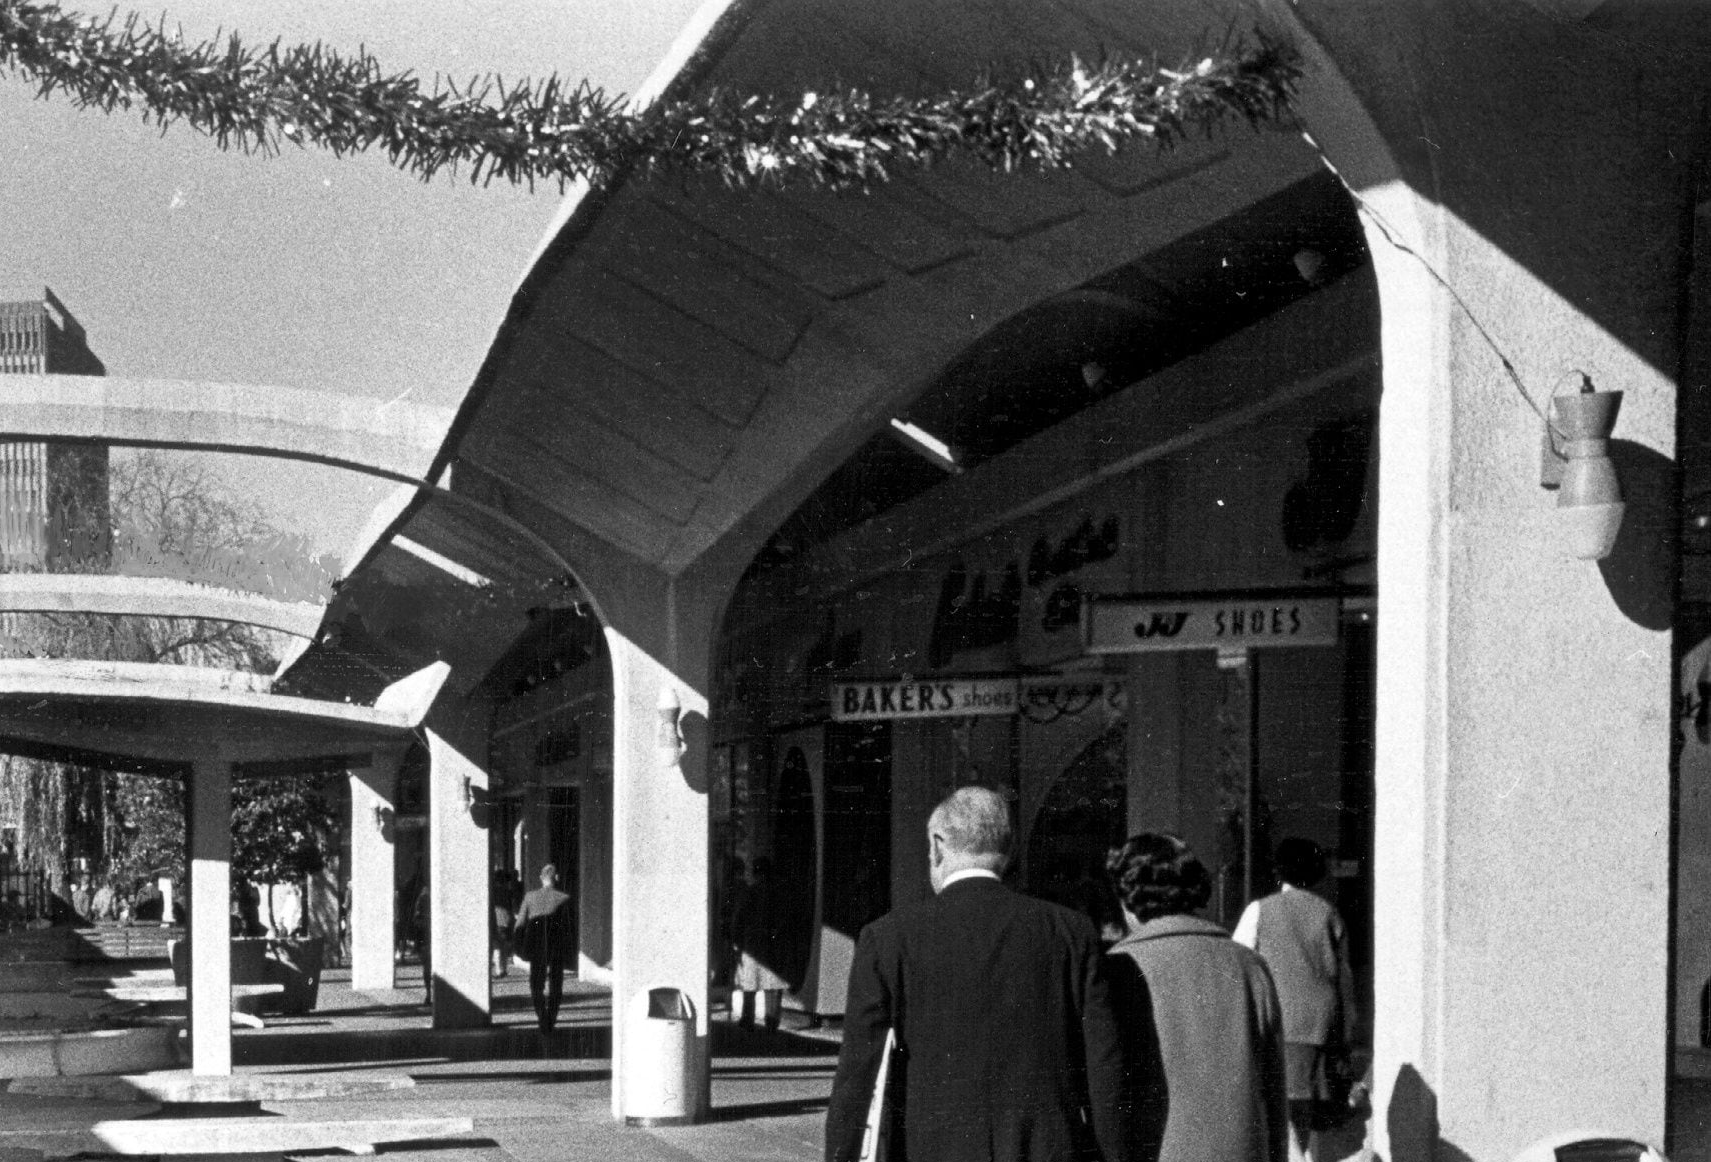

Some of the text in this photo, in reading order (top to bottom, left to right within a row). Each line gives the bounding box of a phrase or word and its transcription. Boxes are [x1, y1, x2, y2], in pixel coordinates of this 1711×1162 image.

[1214, 606, 1302, 637] SHOES
[843, 683, 955, 715] BAKER'S
[962, 684, 1013, 709] shoes
